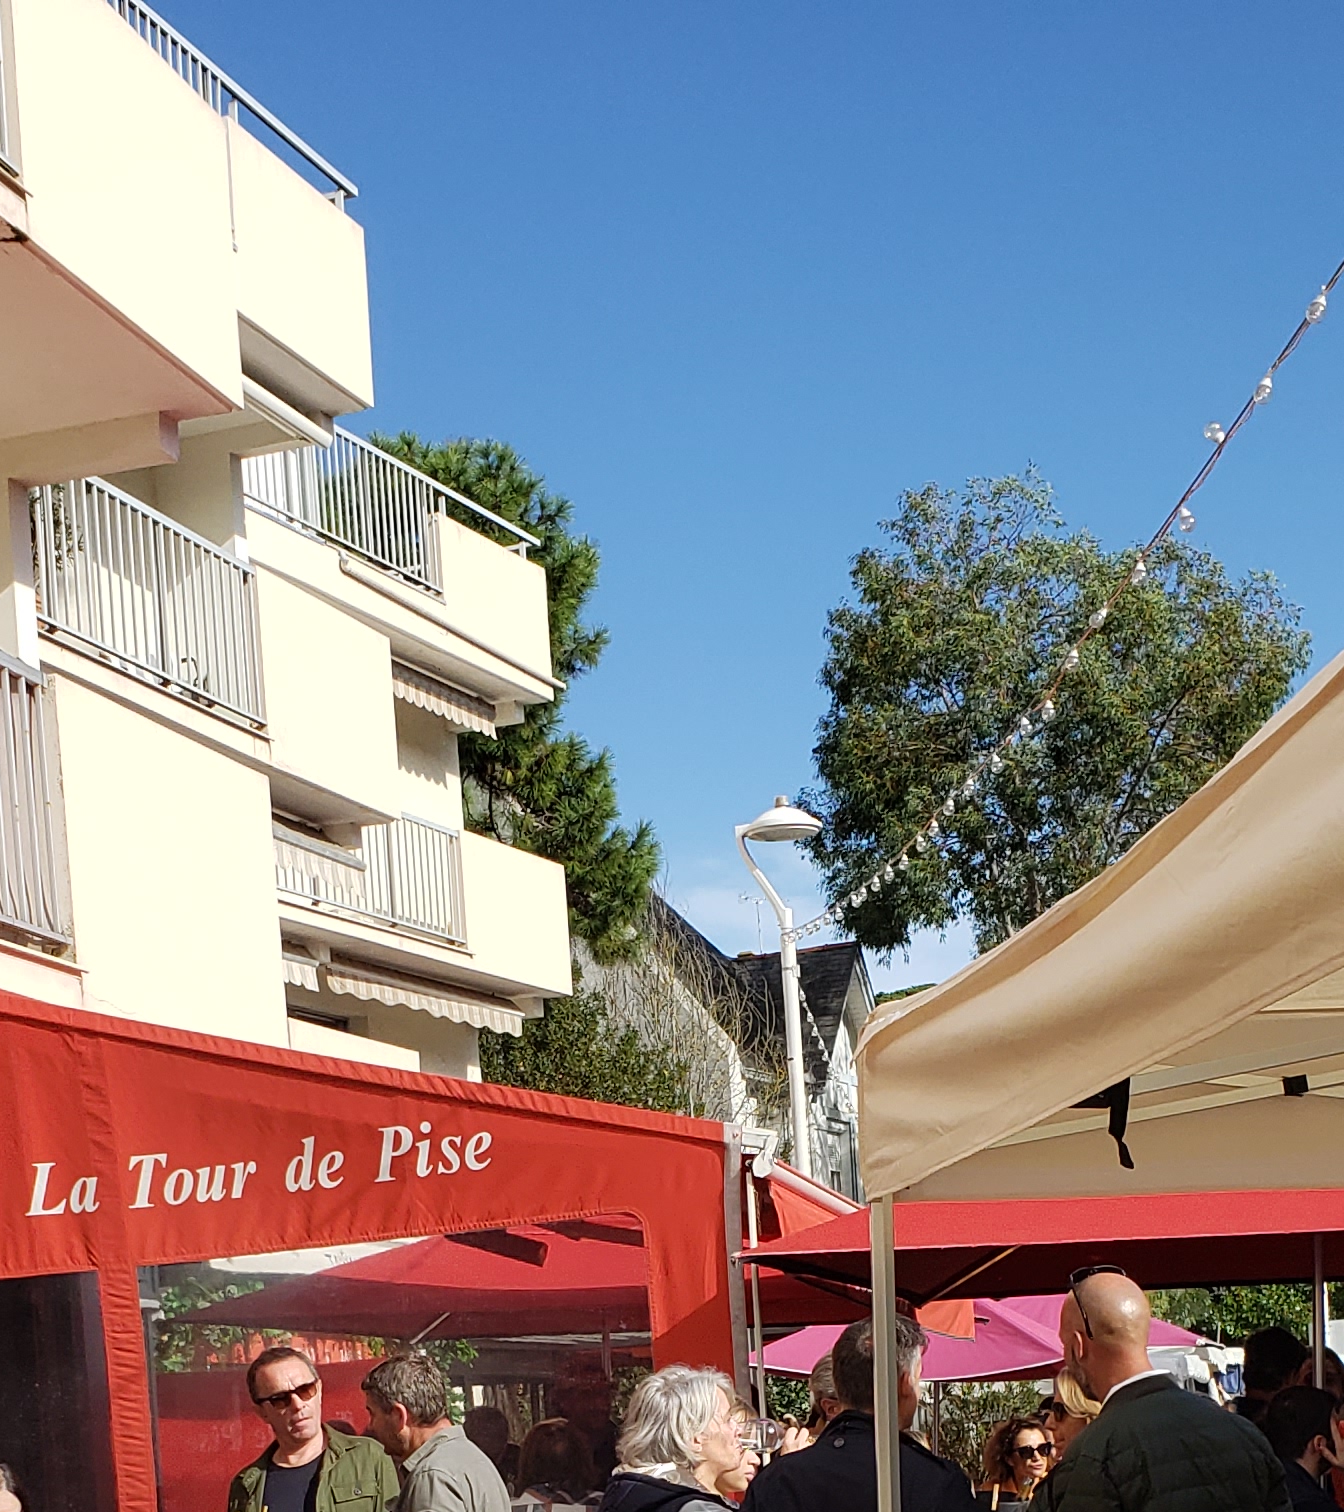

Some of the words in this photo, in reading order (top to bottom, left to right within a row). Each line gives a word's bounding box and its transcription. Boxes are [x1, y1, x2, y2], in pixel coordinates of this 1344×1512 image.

[25, 1162, 99, 1217] La
[128, 1152, 257, 1210] Tour
[285, 1136, 345, 1193] de
[375, 1121, 493, 1184] Pise
